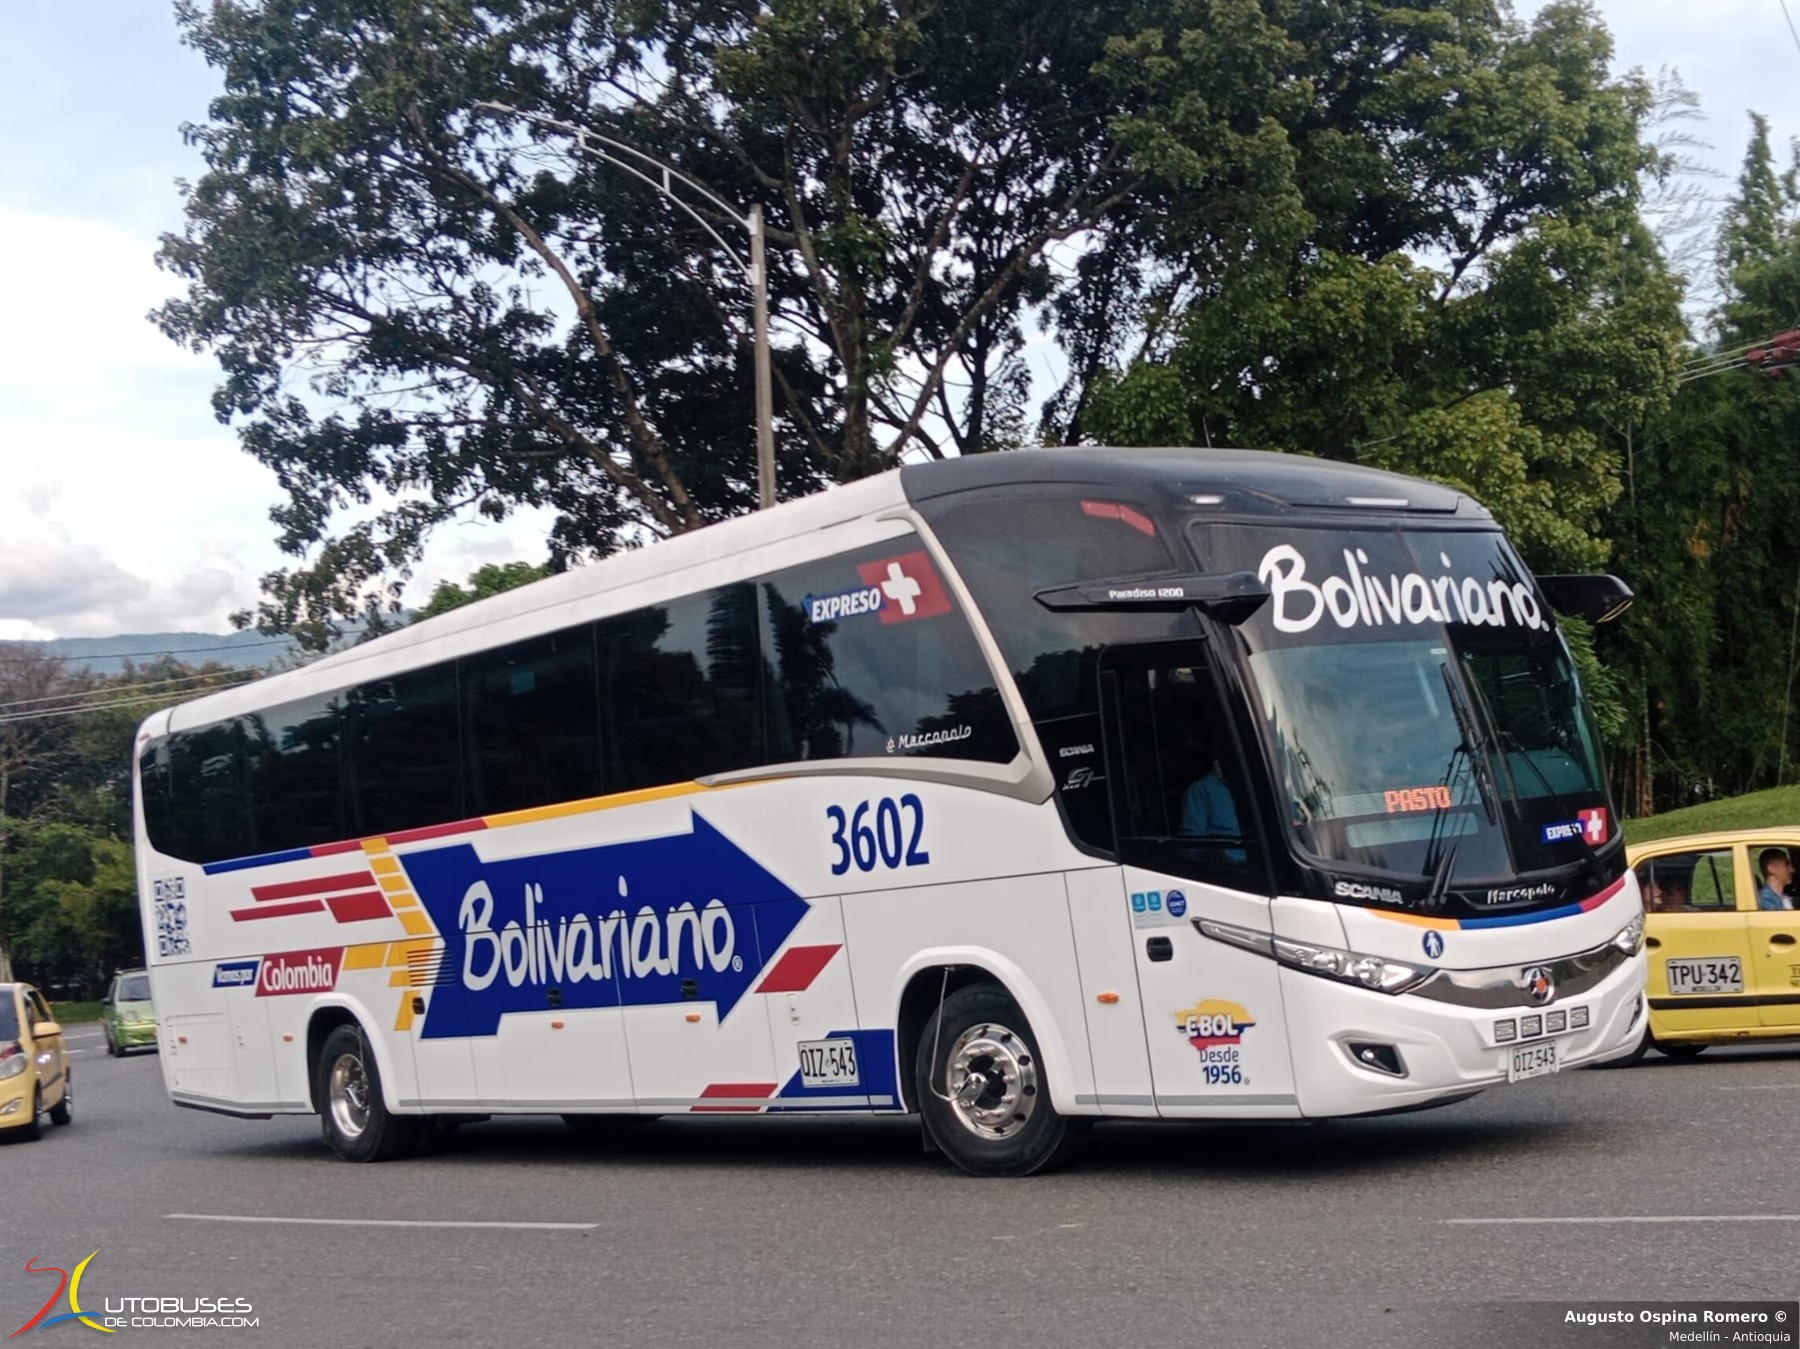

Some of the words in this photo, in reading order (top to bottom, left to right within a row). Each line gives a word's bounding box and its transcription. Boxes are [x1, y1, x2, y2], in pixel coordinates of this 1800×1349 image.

[1108, 588, 1156, 600] Paradiso
[1158, 587, 1184, 598] 1200
[811, 588, 881, 623] EXPRESO
[1384, 786, 1452, 813] PASTO
[826, 793, 930, 876] 3602
[1334, 881, 1404, 904] SCANIA
[1487, 883, 1555, 904] Marcopolo
[262, 955, 333, 991] Colombia
[1200, 1046, 1239, 1063] Desde
[1202, 1065, 1242, 1084] 1956
